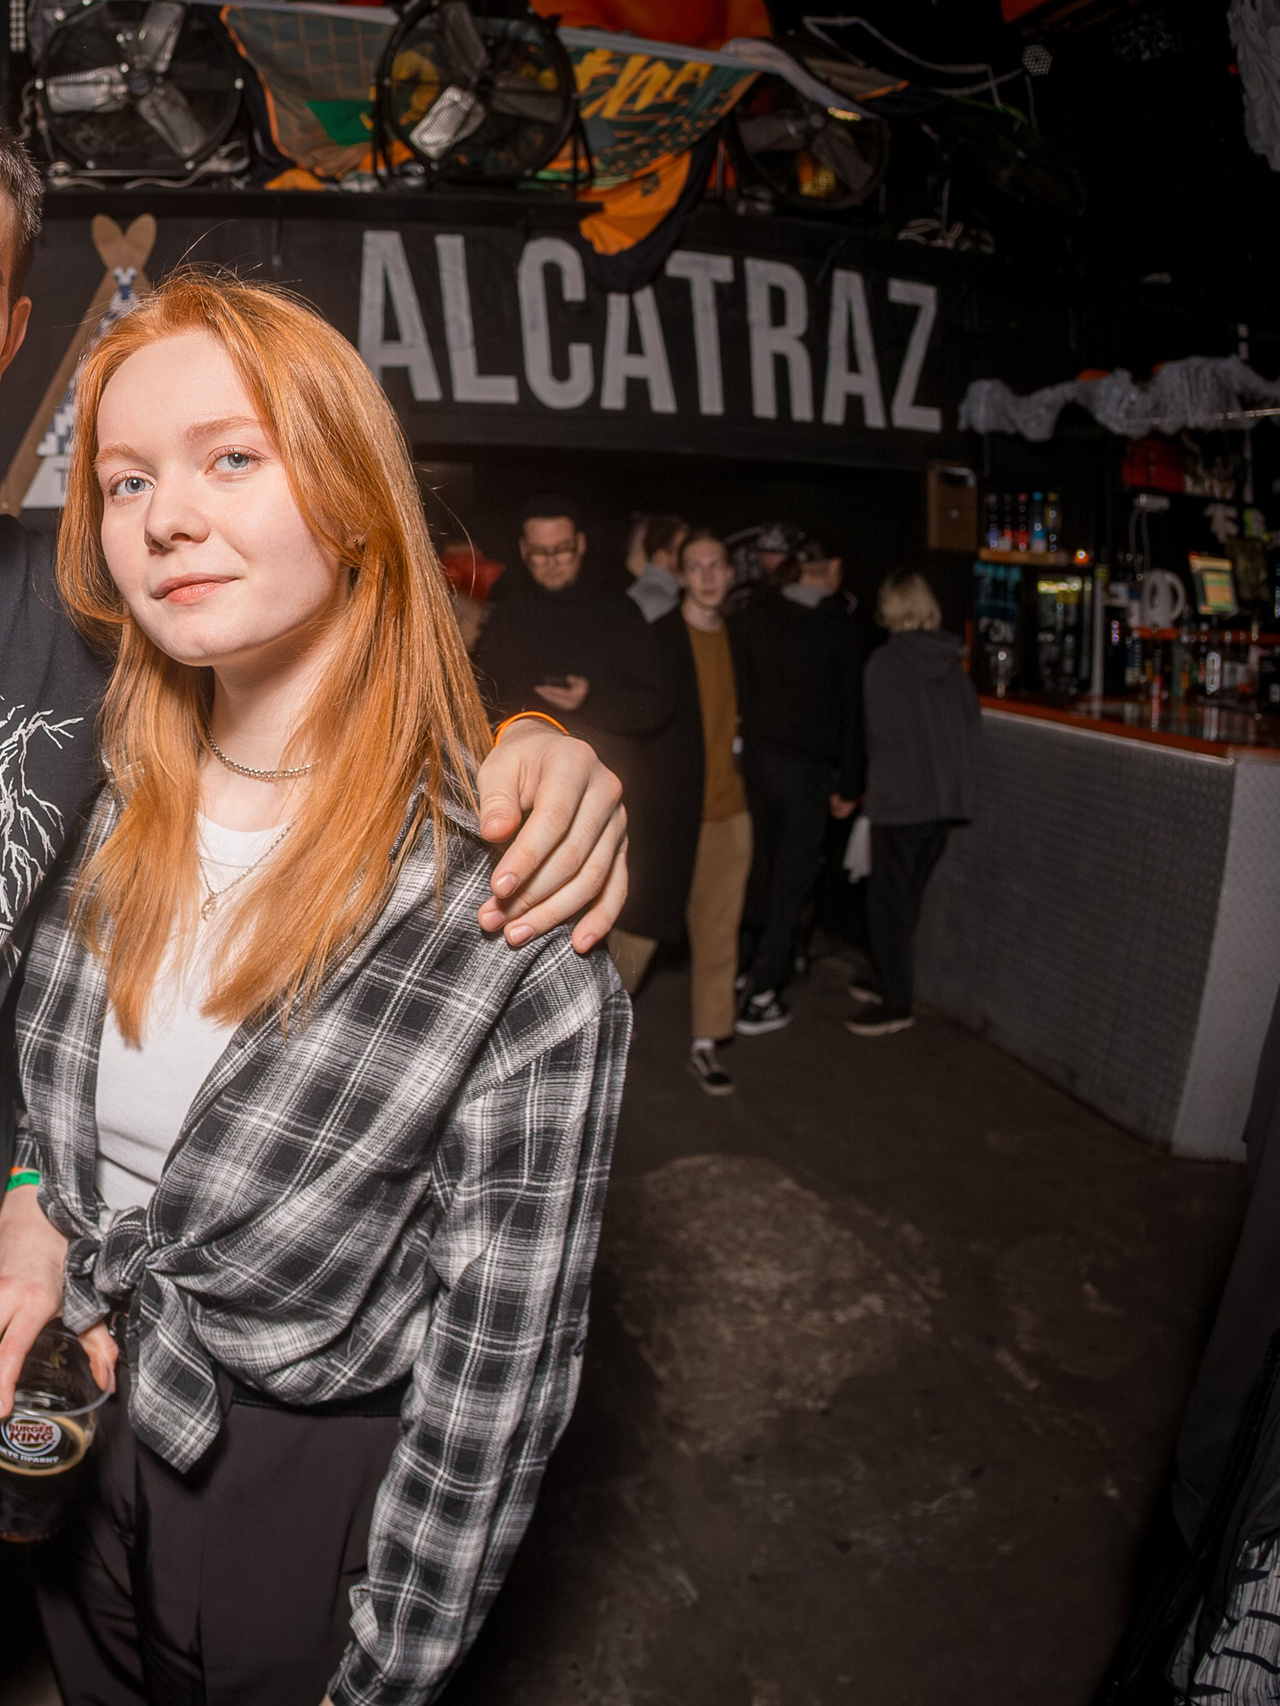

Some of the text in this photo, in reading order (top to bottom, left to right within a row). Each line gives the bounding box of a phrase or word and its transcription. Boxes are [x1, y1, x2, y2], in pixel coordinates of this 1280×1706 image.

[358, 229, 943, 433] ALCATRAZ
[8, 1423, 54, 1434] BURGER
[10, 1432, 54, 1442] KING
